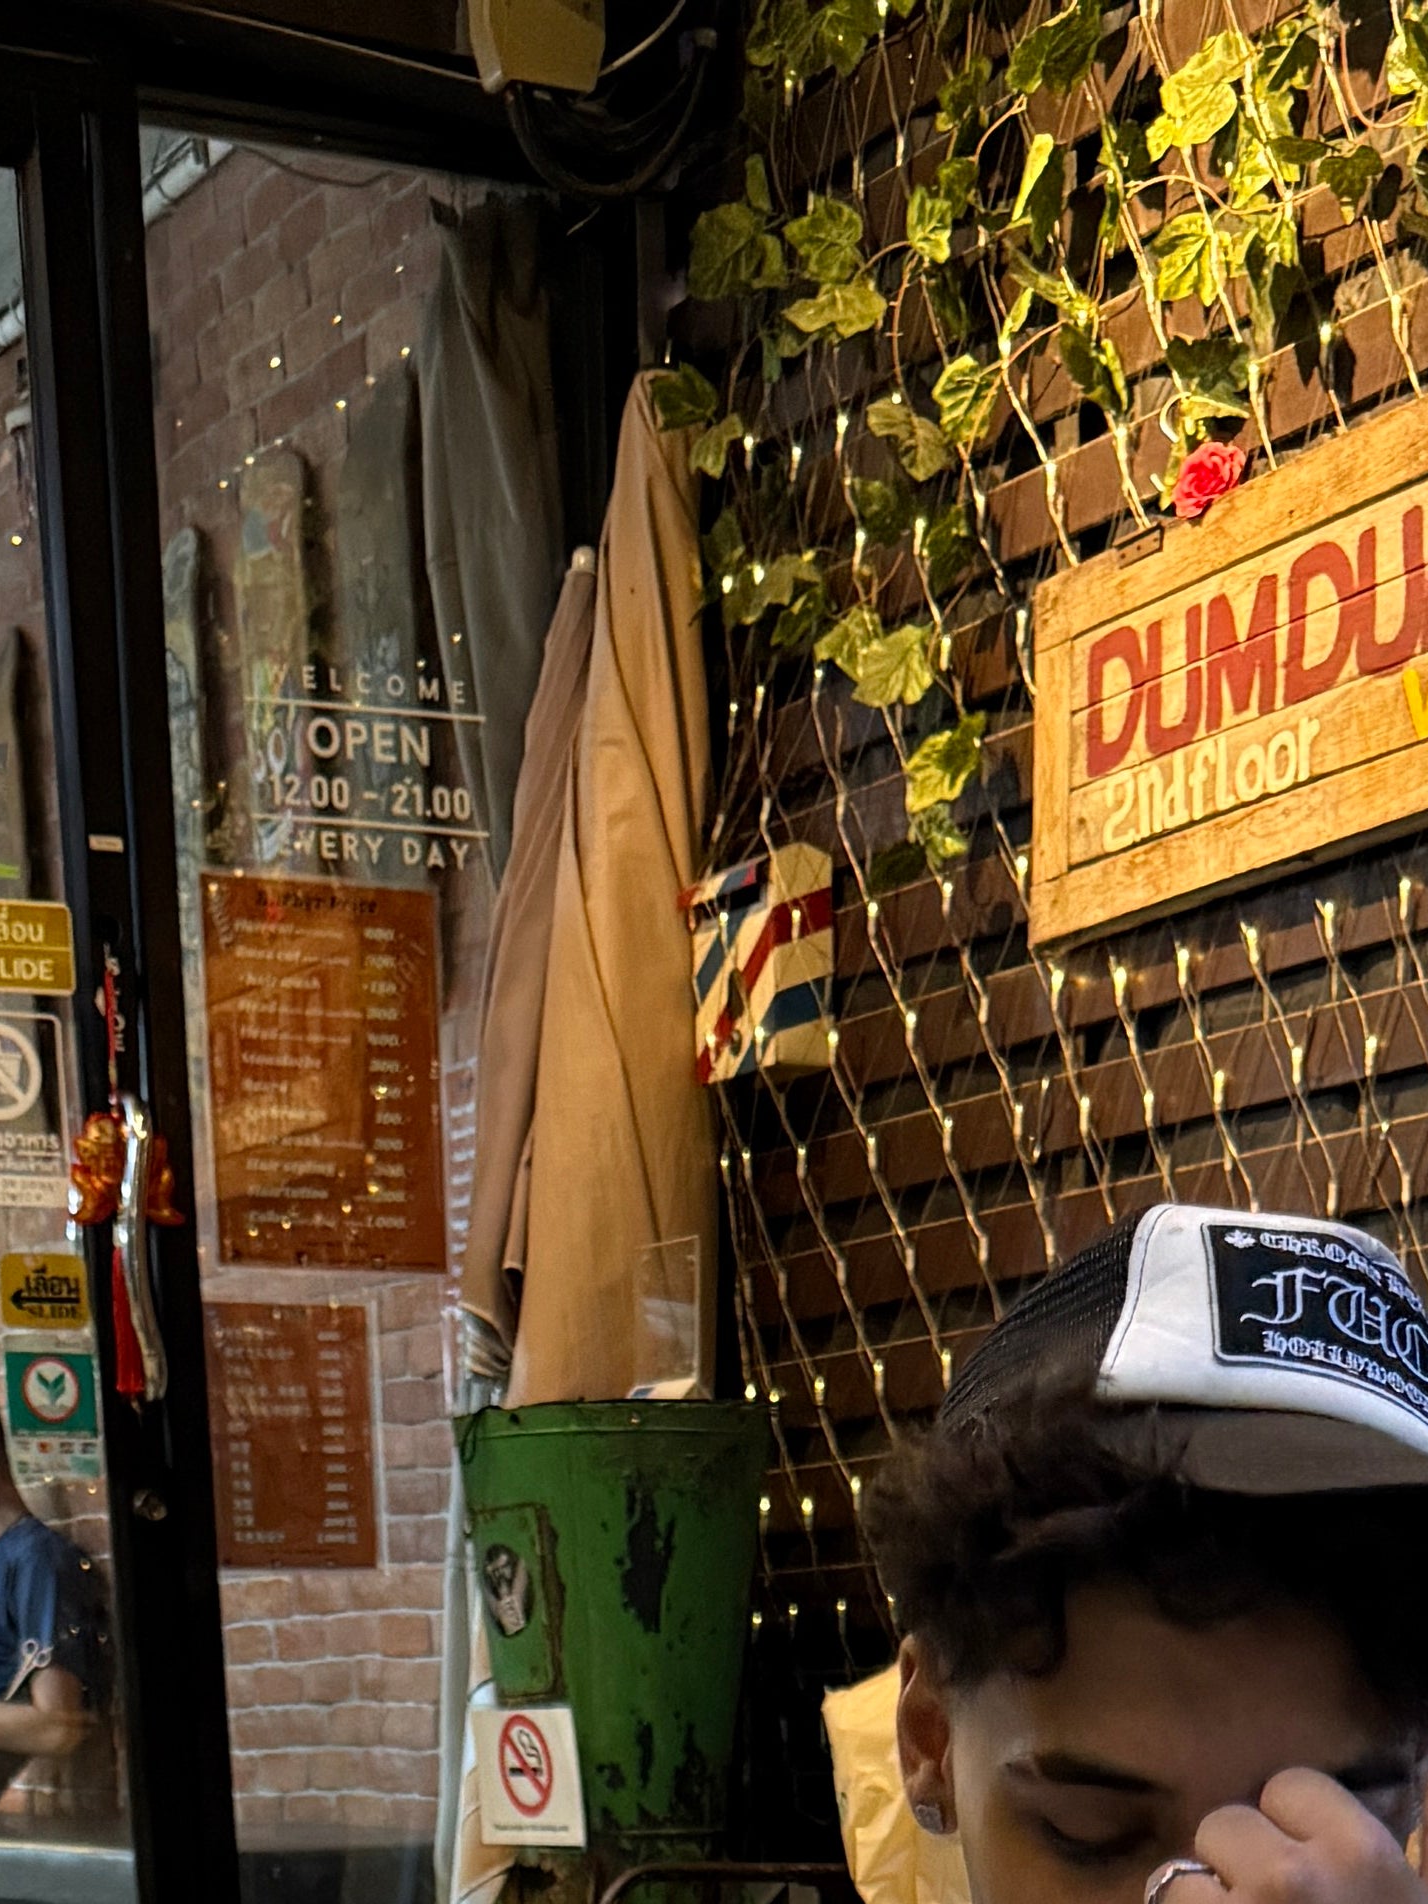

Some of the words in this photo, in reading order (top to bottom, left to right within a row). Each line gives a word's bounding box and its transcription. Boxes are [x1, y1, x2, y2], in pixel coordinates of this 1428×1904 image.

[306, 716, 431, 768] OPEN
[269, 773, 350, 812] 12.00
[390, 779, 471, 821] 21.00
[279, 829, 384, 865] EVERY
[401, 836, 470, 872] DAY
